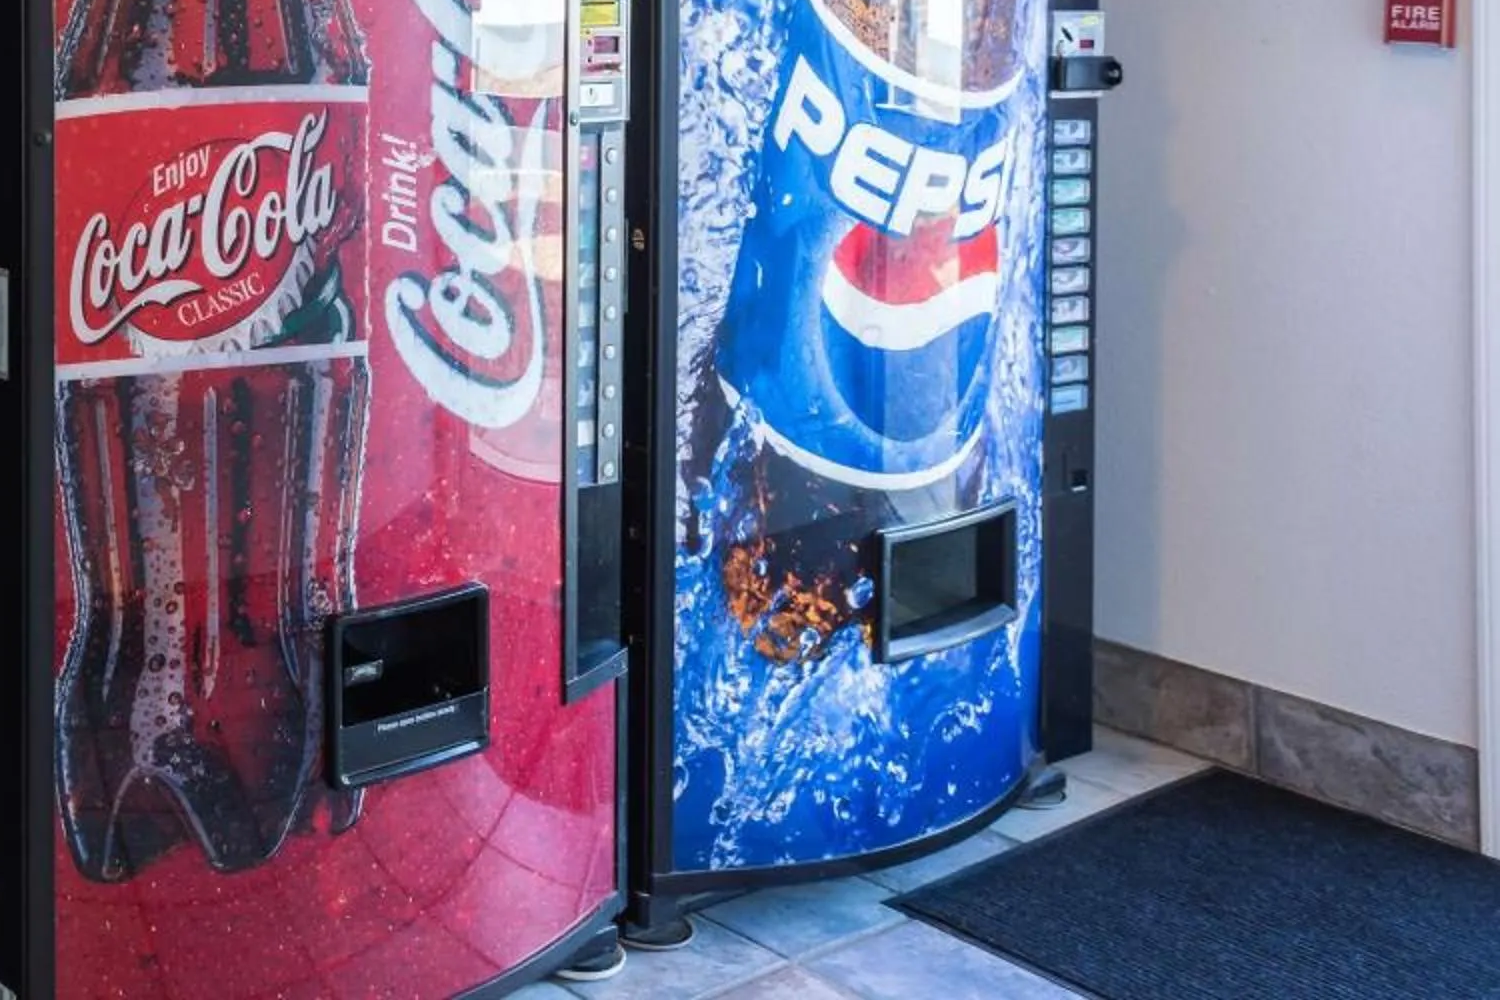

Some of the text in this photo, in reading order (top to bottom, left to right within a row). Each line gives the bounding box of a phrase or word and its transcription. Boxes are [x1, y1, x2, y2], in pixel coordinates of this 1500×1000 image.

[1390, 19, 1440, 31] ALARM
[1391, 5, 1441, 21] FIRE
[151, 143, 212, 198] Enjoy
[381, 132, 421, 252] Drink!
[69, 108, 337, 345] Coca-Cola
[177, 272, 266, 328] CLASSIC
